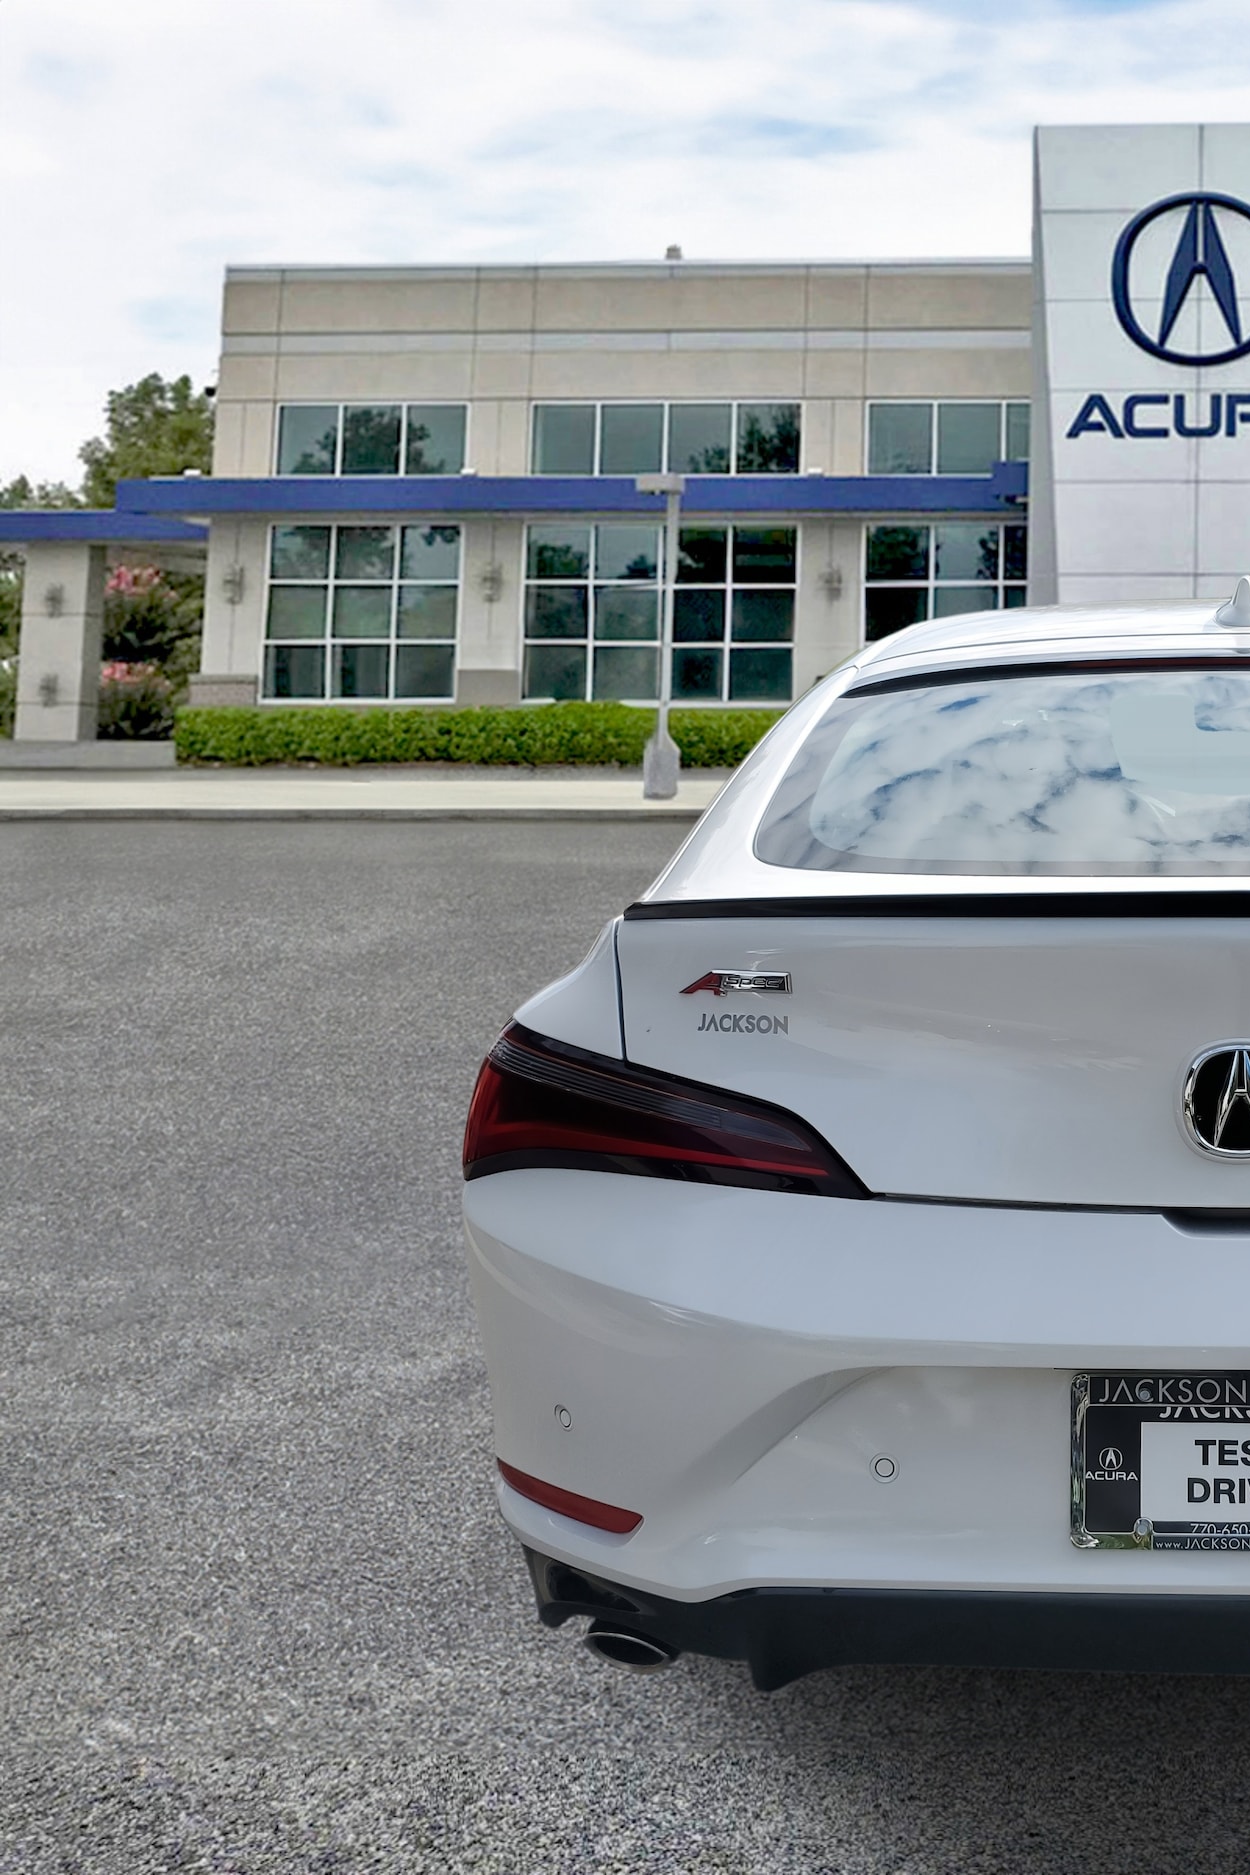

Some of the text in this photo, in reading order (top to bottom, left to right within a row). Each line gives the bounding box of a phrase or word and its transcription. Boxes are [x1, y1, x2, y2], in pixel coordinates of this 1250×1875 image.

[697, 1013, 789, 1035] JACKSON
[1099, 1378, 1247, 1404] JACKSON
[1085, 1470, 1139, 1481] ACURA
